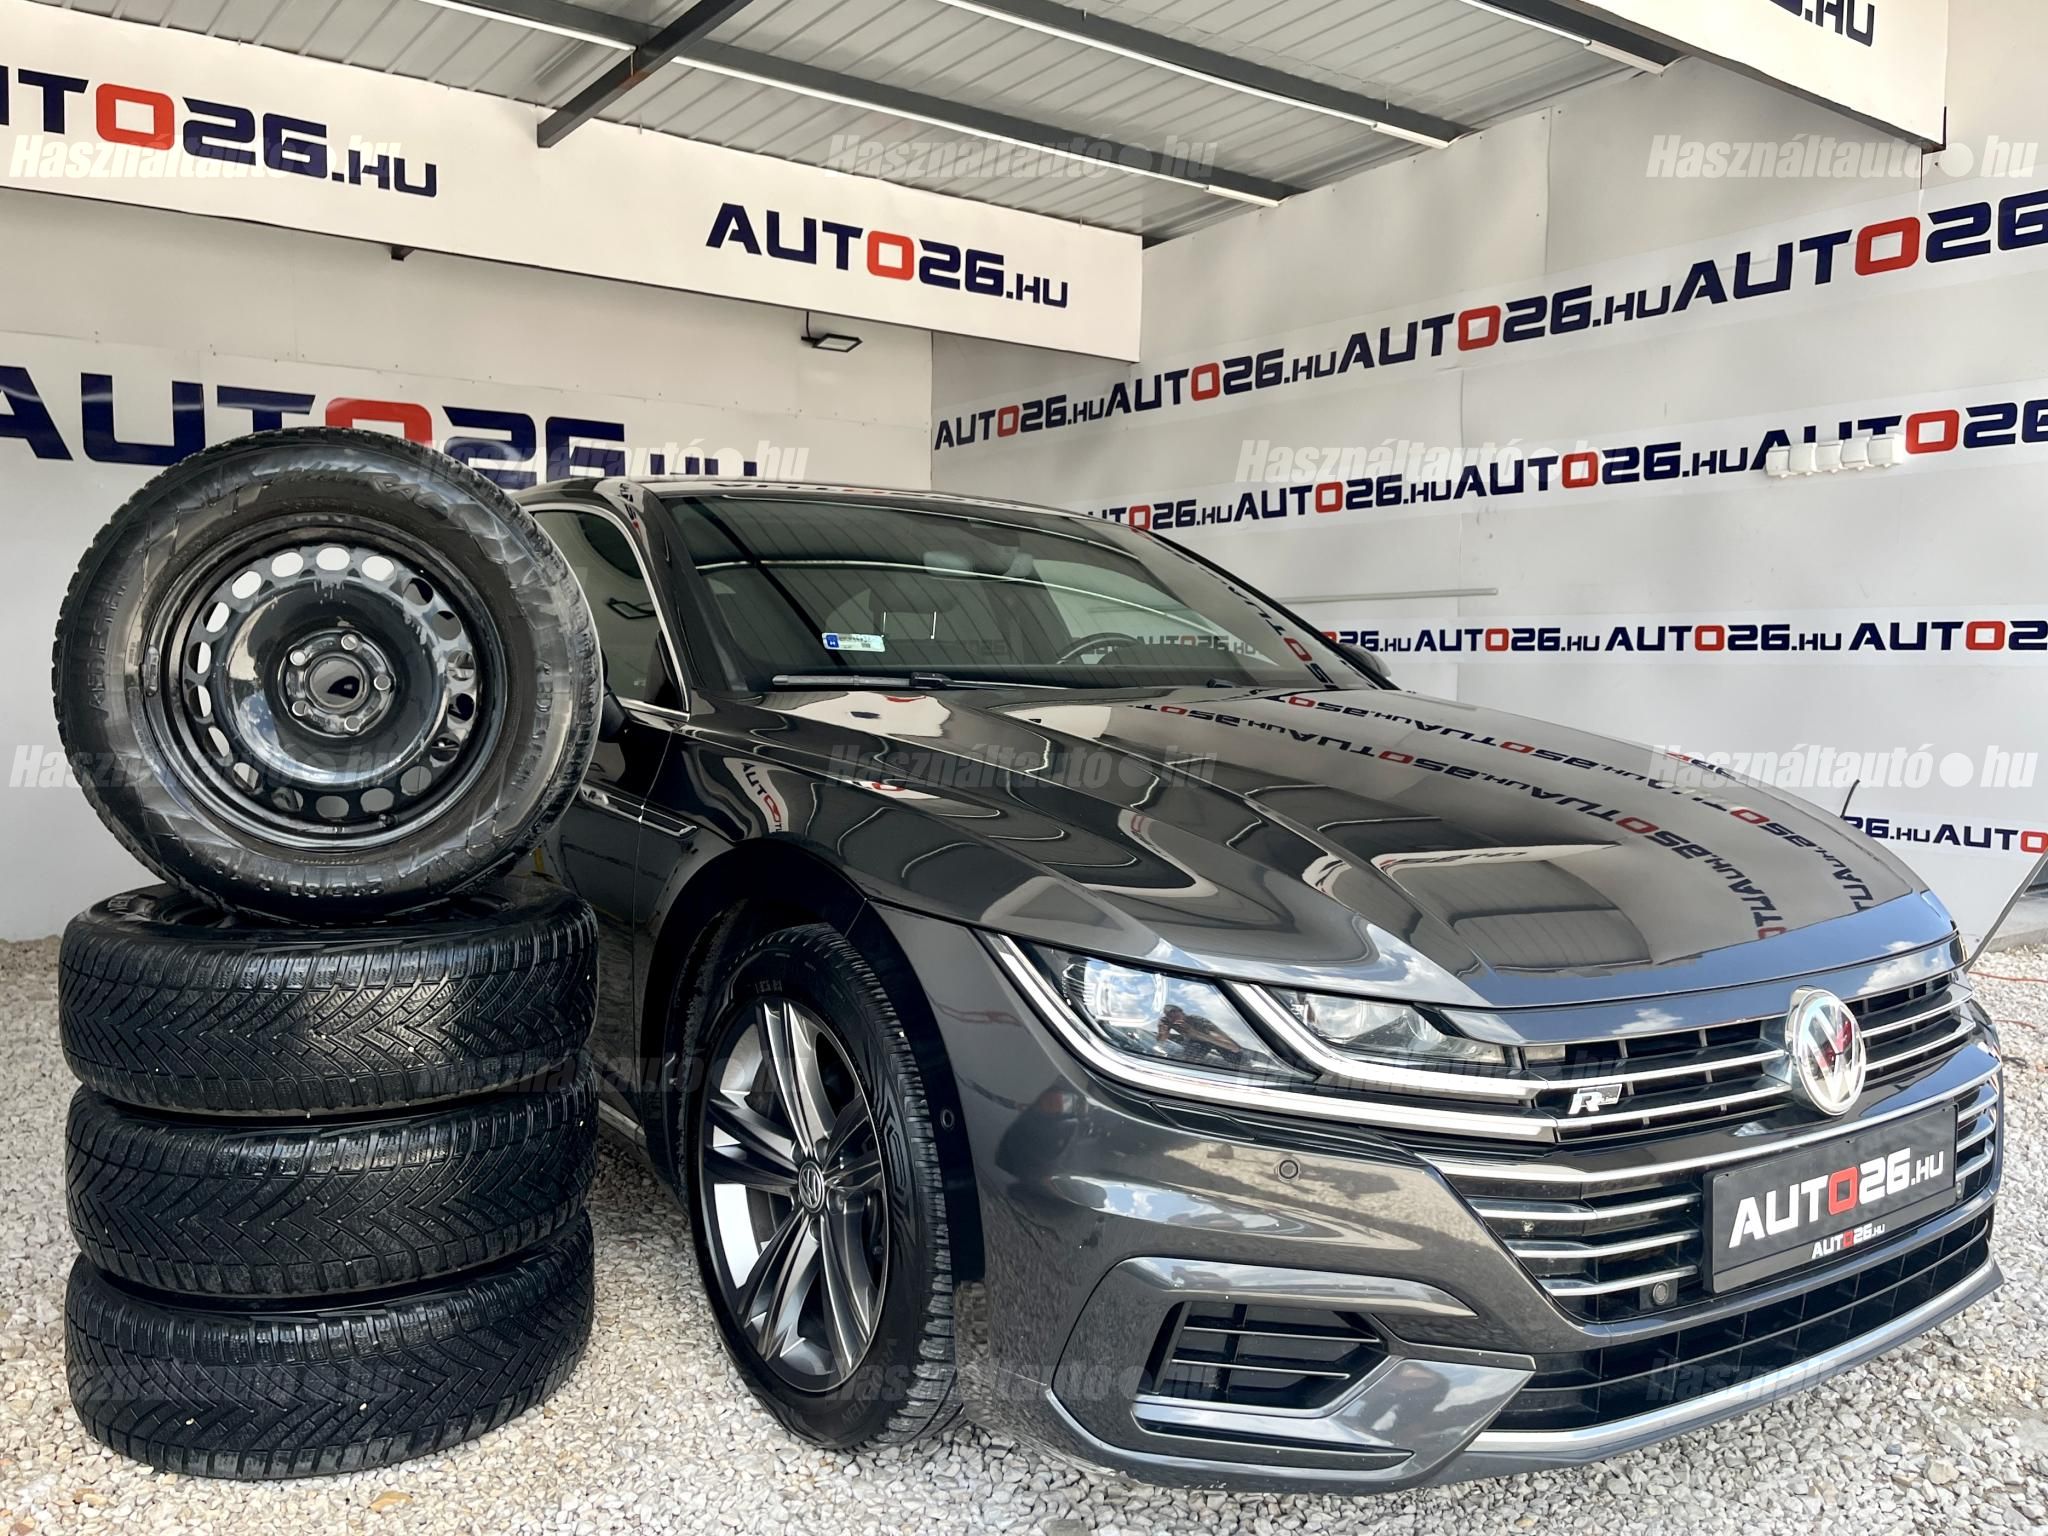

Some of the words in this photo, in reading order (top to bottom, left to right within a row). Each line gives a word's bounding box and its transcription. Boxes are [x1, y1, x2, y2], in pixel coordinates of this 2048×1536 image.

[1770, 0, 1875, 47] .HU
[0, 65, 437, 197] TO26.HU
[706, 202, 1068, 309] AUTO26.HU
[934, 395, 1105, 451] AUTO26.HU
[1105, 348, 1337, 417] AUTO26.HU
[1337, 285, 1671, 374] AUTO26.HU
[1672, 189, 2048, 312] AUTO26
[1088, 498, 1233, 531] TO26.HU
[1233, 473, 1452, 522] AUTO26.HU
[1453, 442, 1749, 499] AUTO26.HU
[1322, 630, 1411, 652] 26.HU
[1414, 628, 1600, 652] AUTO26.HU
[1605, 623, 1841, 651] AUTO26.HU
[1848, 620, 2048, 651] AUTO2
[1933, 824, 2048, 853] AUTO
[1728, 1147, 1944, 1249] AUTO26.HU
[1811, 1222, 1885, 1260] AUTO26.HU
